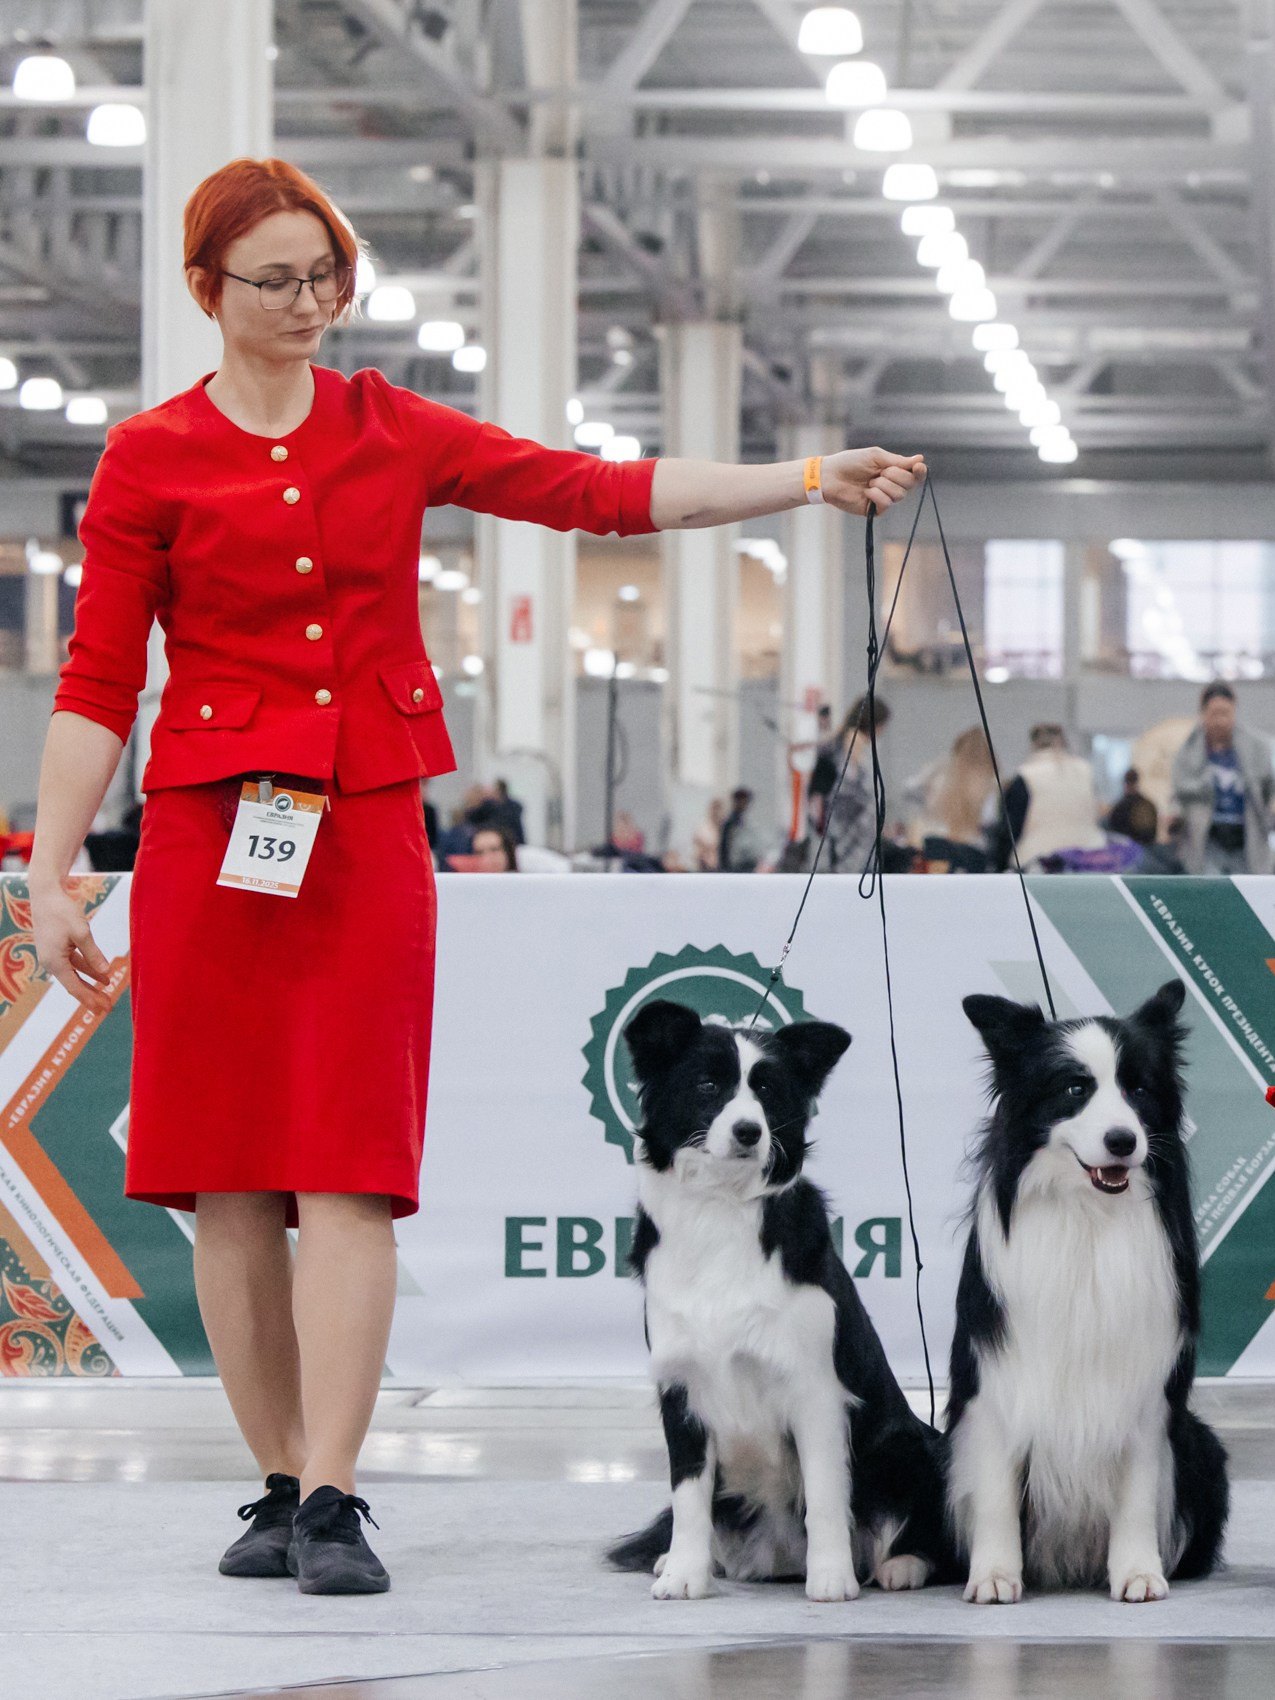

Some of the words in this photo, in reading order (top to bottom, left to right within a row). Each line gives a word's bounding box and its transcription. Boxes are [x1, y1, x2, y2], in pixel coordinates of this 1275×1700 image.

[248, 835, 296, 862] 139
[242, 877, 279, 889] 16.11.2025
[1192, 954, 1225, 997] КУБОК
[51, 1025, 86, 1067] КУБОК
[1215, 1156, 1247, 1193] СОБАК
[15, 1193, 81, 1284] КИНОЛОГИЧЕСКАЯ
[80, 1284, 125, 1342] ФЕДЕРАЦИЯ
